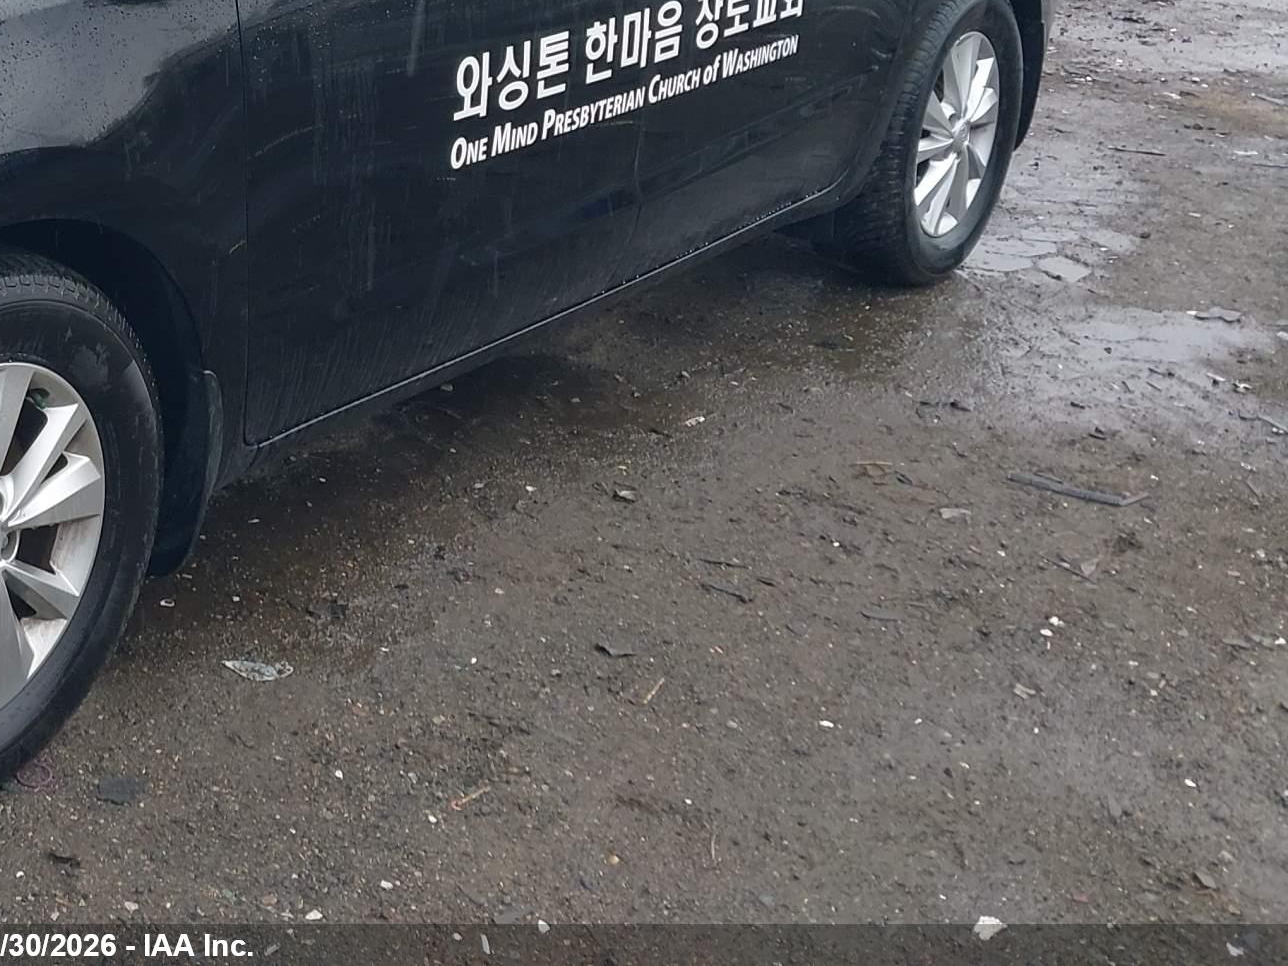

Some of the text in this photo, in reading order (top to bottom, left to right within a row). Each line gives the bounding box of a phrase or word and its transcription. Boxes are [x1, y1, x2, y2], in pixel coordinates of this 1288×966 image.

[453, 30, 570, 121] 와싱톤
[585, 0, 683, 85] 한마음
[703, 54, 722, 85] of
